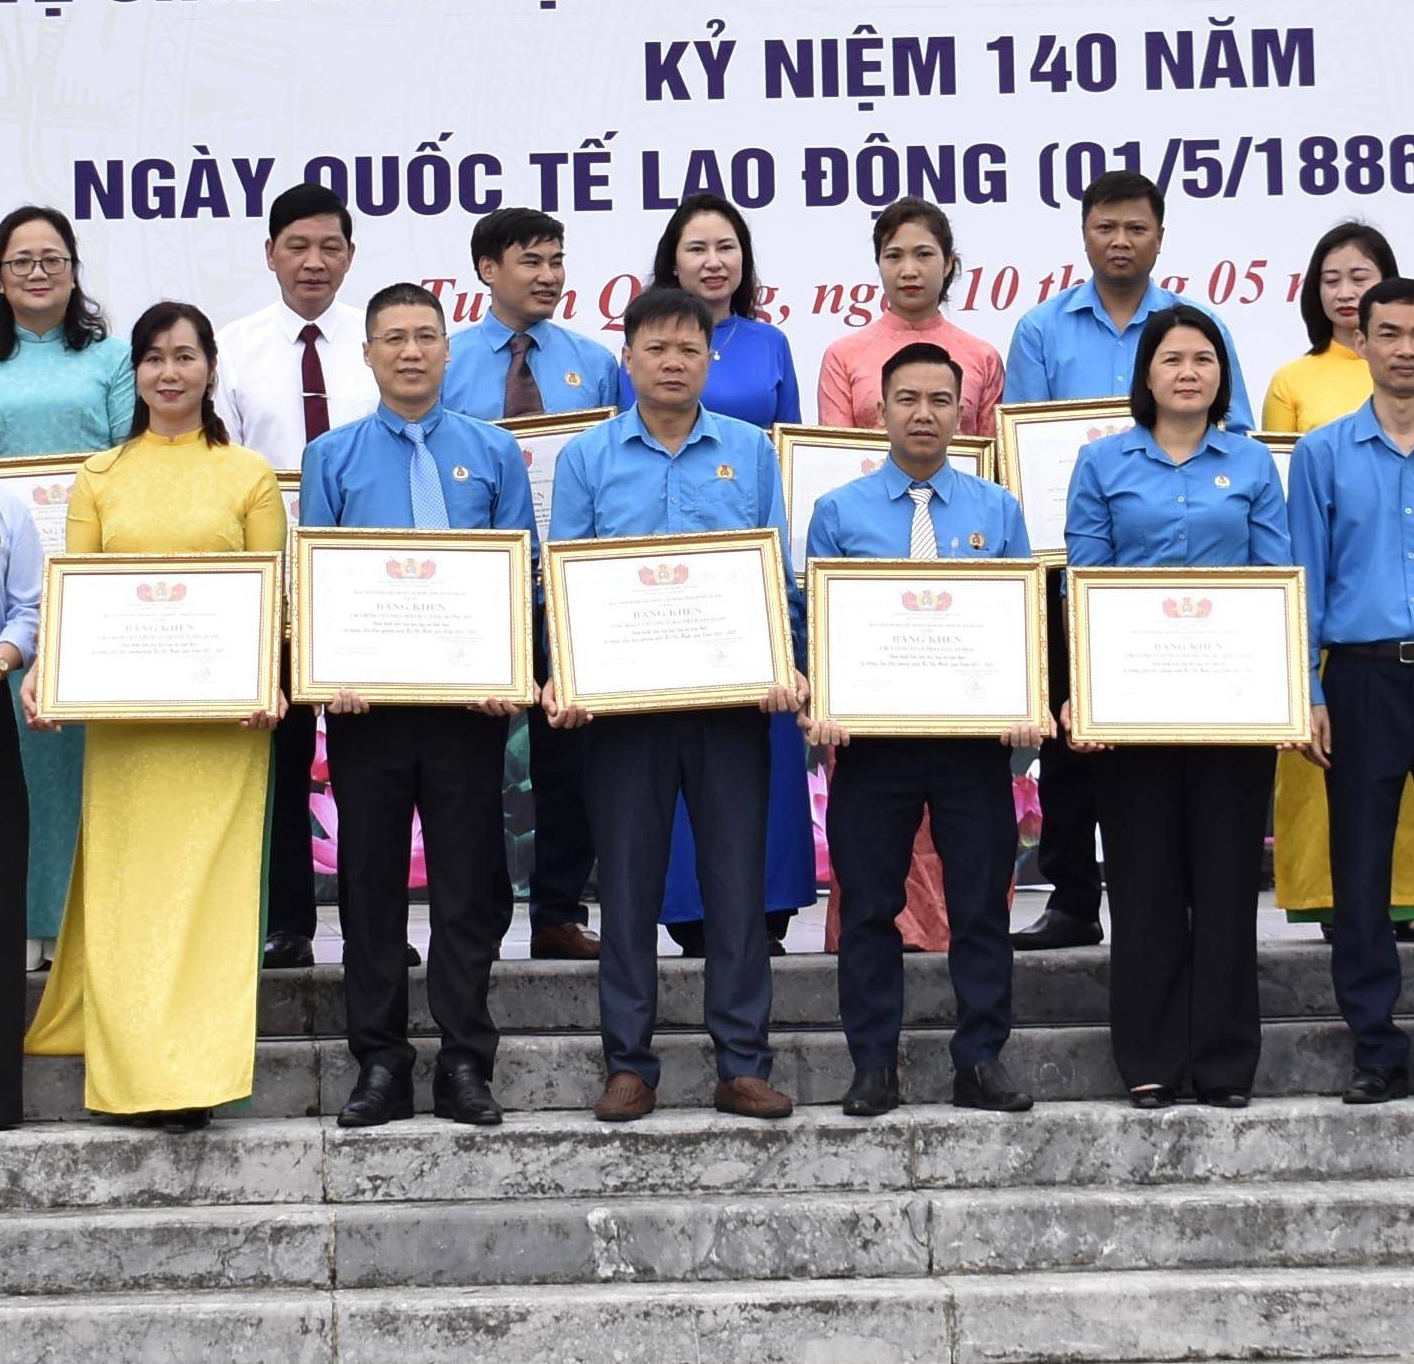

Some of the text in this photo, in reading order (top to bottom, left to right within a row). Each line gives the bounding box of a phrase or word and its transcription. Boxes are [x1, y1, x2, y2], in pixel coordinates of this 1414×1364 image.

[644, 16, 1316, 112] KỶ NIỆM 140 NĂM
[74, 144, 276, 221] NGÀY
[529, 130, 619, 213] TẾ
[641, 147, 776, 211] LAO
[801, 132, 1007, 221] ĐỘNG
[958, 265, 1020, 312] 10
[1207, 259, 1268, 306] 05
